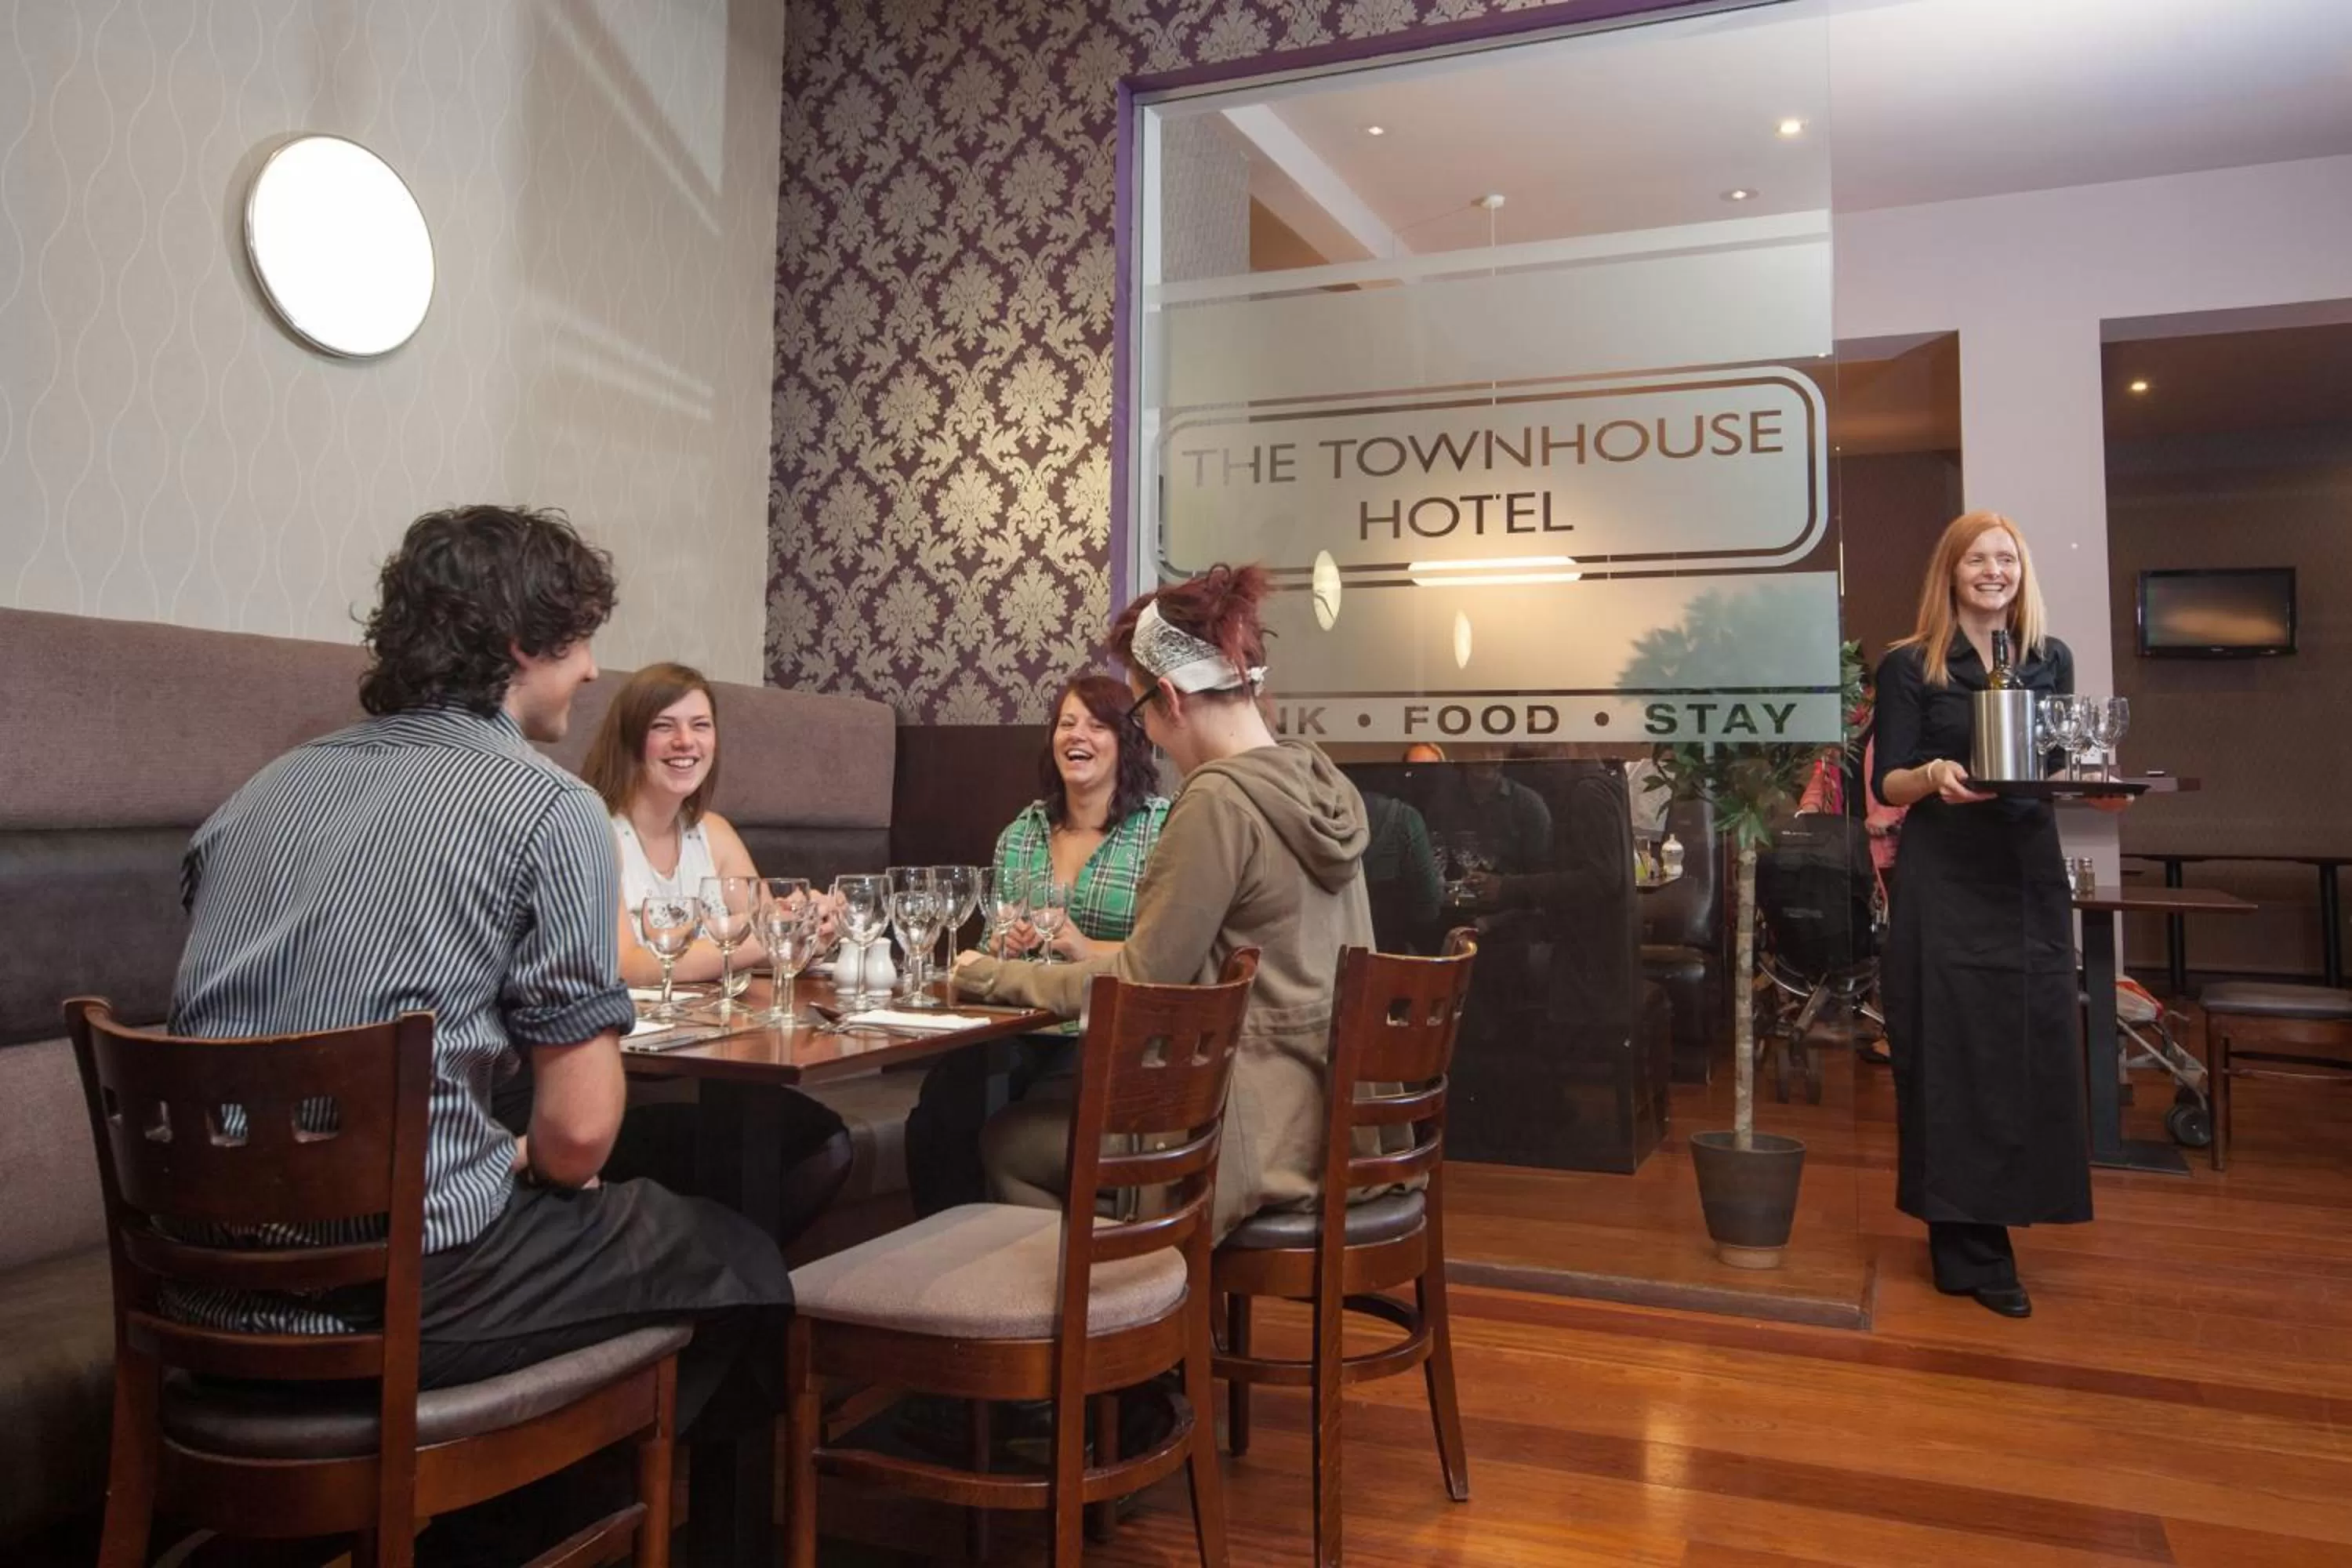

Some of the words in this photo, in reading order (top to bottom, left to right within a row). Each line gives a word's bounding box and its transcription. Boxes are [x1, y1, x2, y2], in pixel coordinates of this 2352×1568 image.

[1181, 442, 1296, 488] THE
[1319, 410, 1784, 479] TOWNHOUSE
[1360, 492, 1574, 540] HOTEL
[1404, 704, 1561, 735] FOOD
[1644, 702, 1797, 735] STAY
